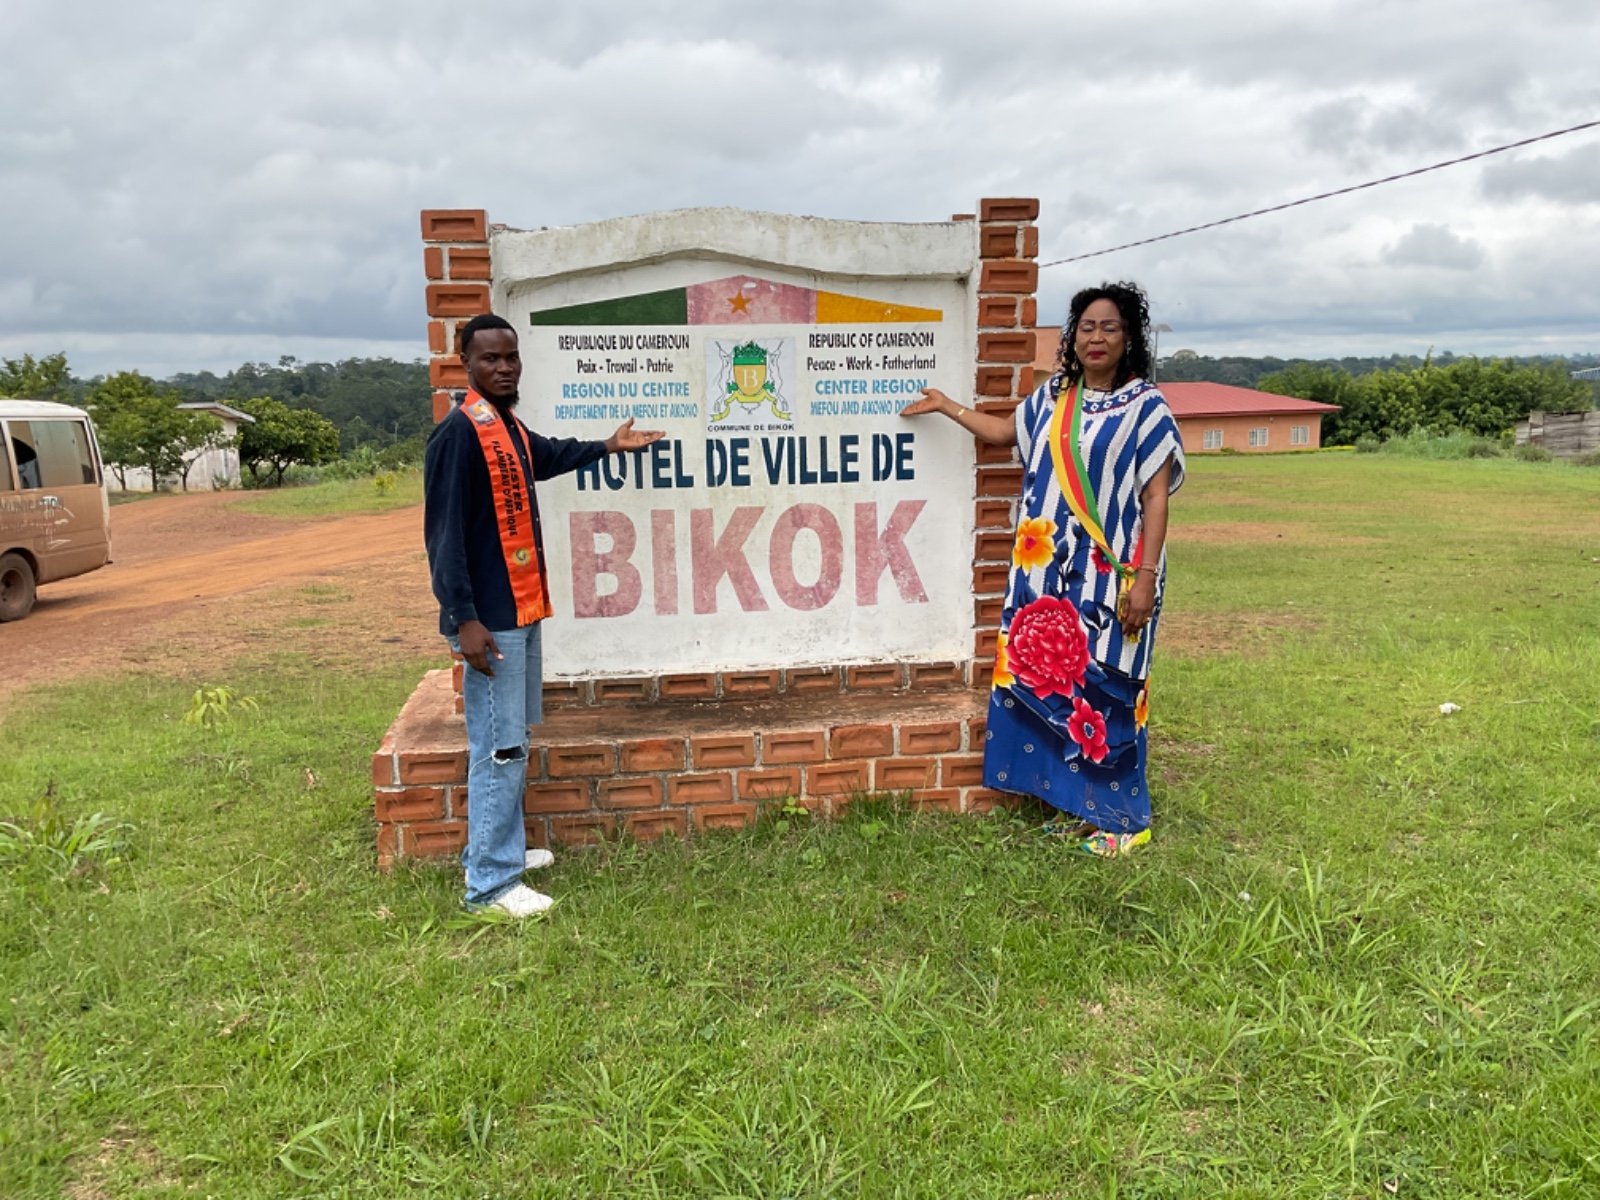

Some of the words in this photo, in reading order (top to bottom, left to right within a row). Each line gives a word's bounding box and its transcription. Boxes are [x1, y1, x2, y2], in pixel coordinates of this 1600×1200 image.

[558, 334, 617, 351] REPUBLIQUE
[619, 335, 634, 350] DU
[636, 334, 690, 350] CAMEROUN
[809, 333, 857, 349] REPUBLIC
[859, 333, 874, 348] OF
[876, 331, 934, 348] CAMEROON
[577, 358, 598, 374] Paix
[605, 357, 638, 373] Travail
[646, 356, 674, 373] Patrie
[806, 356, 836, 371] Peace
[846, 355, 873, 371] Work
[881, 353, 936, 370] Fatherland
[562, 382, 616, 399] REGION
[618, 382, 638, 399] DU
[642, 382, 690, 398] CENTRE
[814, 379, 868, 395] CENTER
[872, 378, 928, 395] REGION
[555, 404, 607, 420] DEPARTEMENT
[608, 404, 619, 419] DE
[620, 404, 632, 419] LA
[659, 403, 668, 418] ET
[810, 400, 839, 416] MEFOU
[841, 400, 860, 416] AND
[707, 424, 751, 433] COMMUNE
[753, 423, 765, 431] DE
[767, 423, 795, 432] BIKOK
[706, 437, 751, 488] DE
[762, 434, 860, 486] VILLE
[872, 432, 916, 482] DE
[506, 453, 523, 512] MISTER
[569, 498, 930, 619] BIKOK
